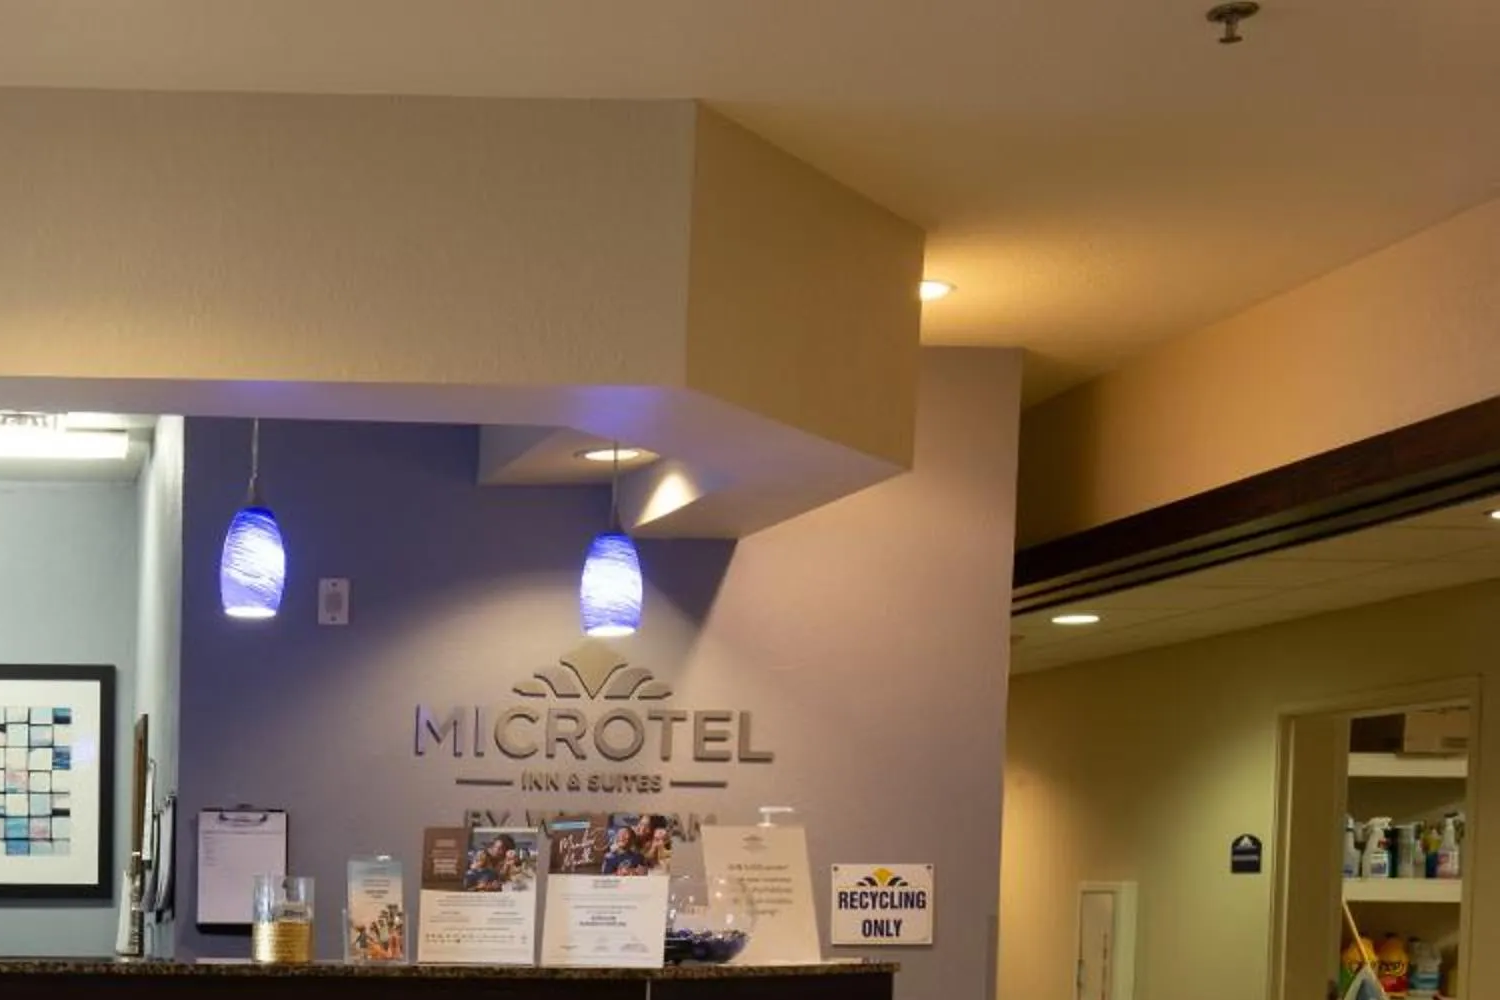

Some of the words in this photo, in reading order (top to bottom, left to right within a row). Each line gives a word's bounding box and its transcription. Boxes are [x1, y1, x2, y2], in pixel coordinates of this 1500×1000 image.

[414, 703, 774, 764] MICROTEL
[521, 770, 559, 792] INN
[567, 773, 581, 793] &
[586, 773, 662, 794] SUITES
[838, 890, 927, 909] RECYCLING
[862, 918, 902, 937] ONLY
